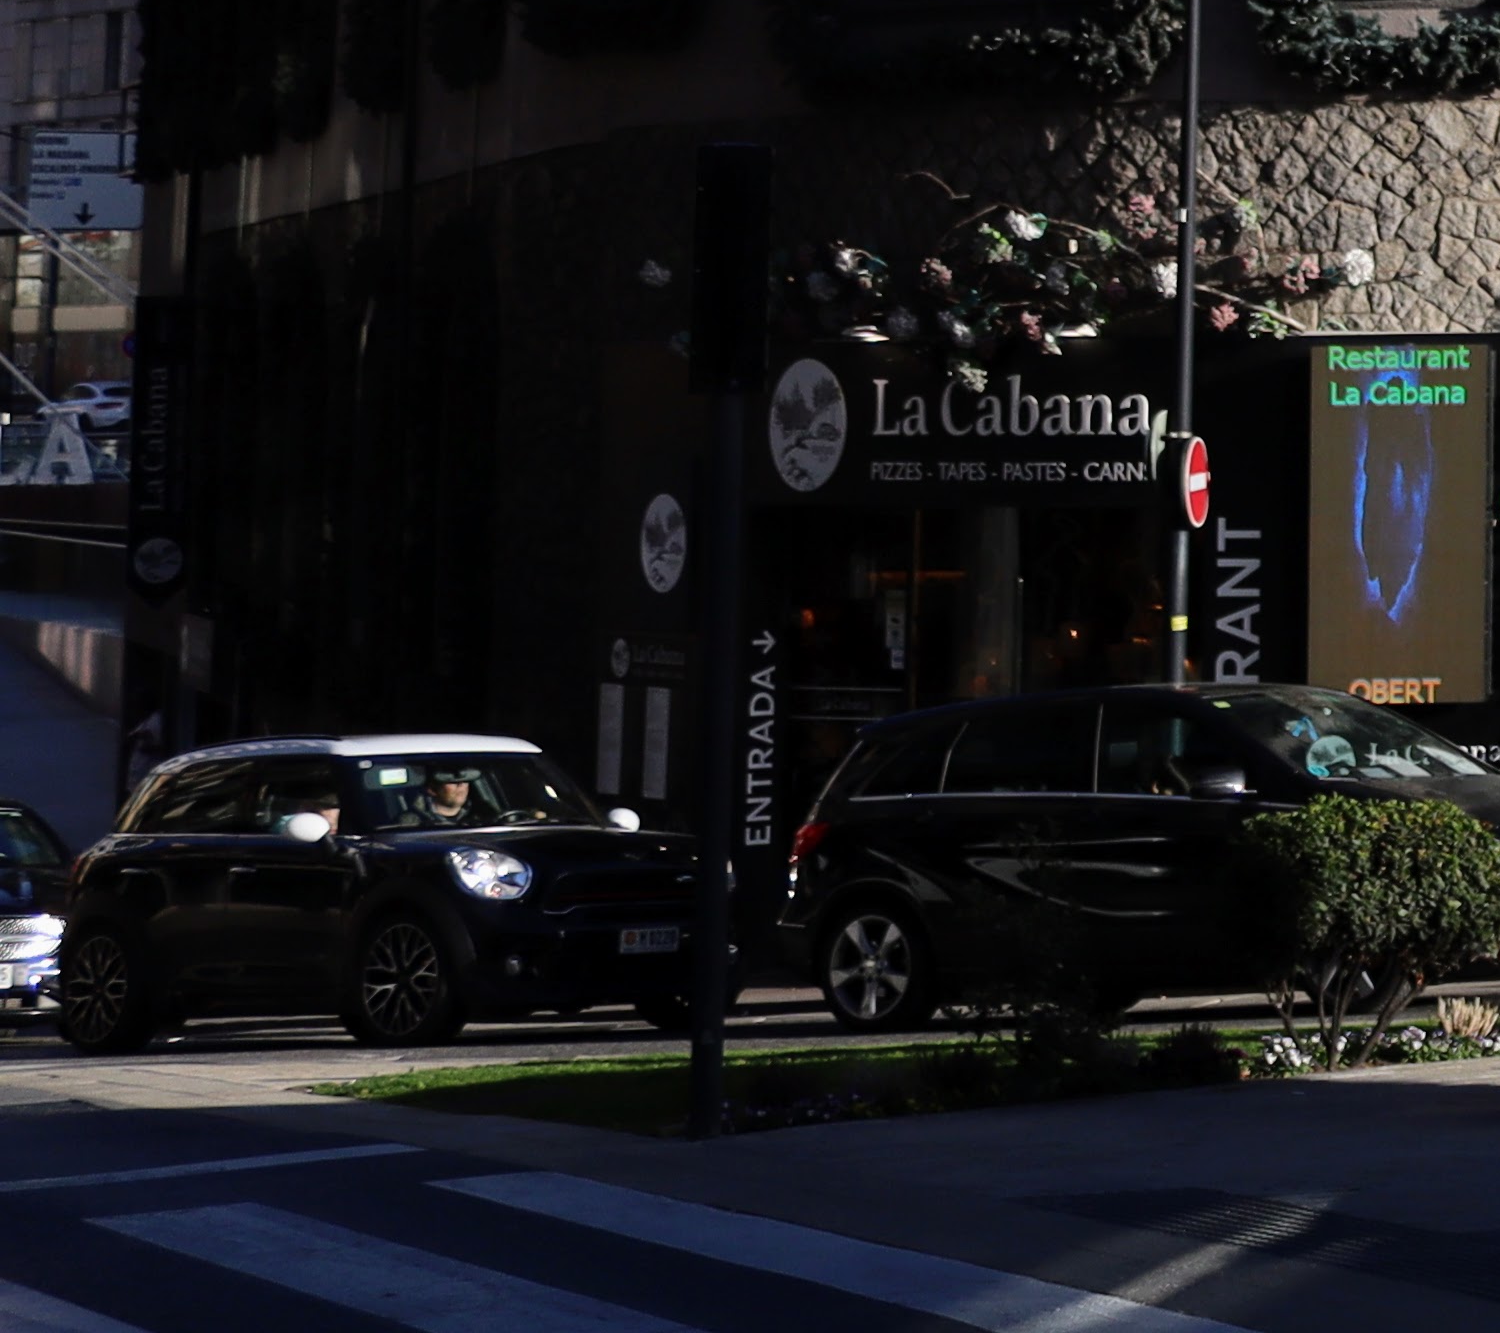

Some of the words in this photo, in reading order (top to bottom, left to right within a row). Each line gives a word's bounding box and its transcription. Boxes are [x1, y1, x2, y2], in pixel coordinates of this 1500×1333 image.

[1328, 345, 1472, 371] Restaurant
[872, 378, 929, 436] La
[940, 373, 1151, 436] Cabana
[1330, 381, 1361, 406] La
[1369, 380, 1467, 406] Cabana
[871, 461, 923, 482] PIZZES
[938, 461, 988, 482] TAPES
[1003, 461, 1067, 482] PASTES
[1083, 461, 1148, 483] CARN
[1350, 677, 1442, 705] OBERT
[745, 665, 776, 846] ENTRADA
